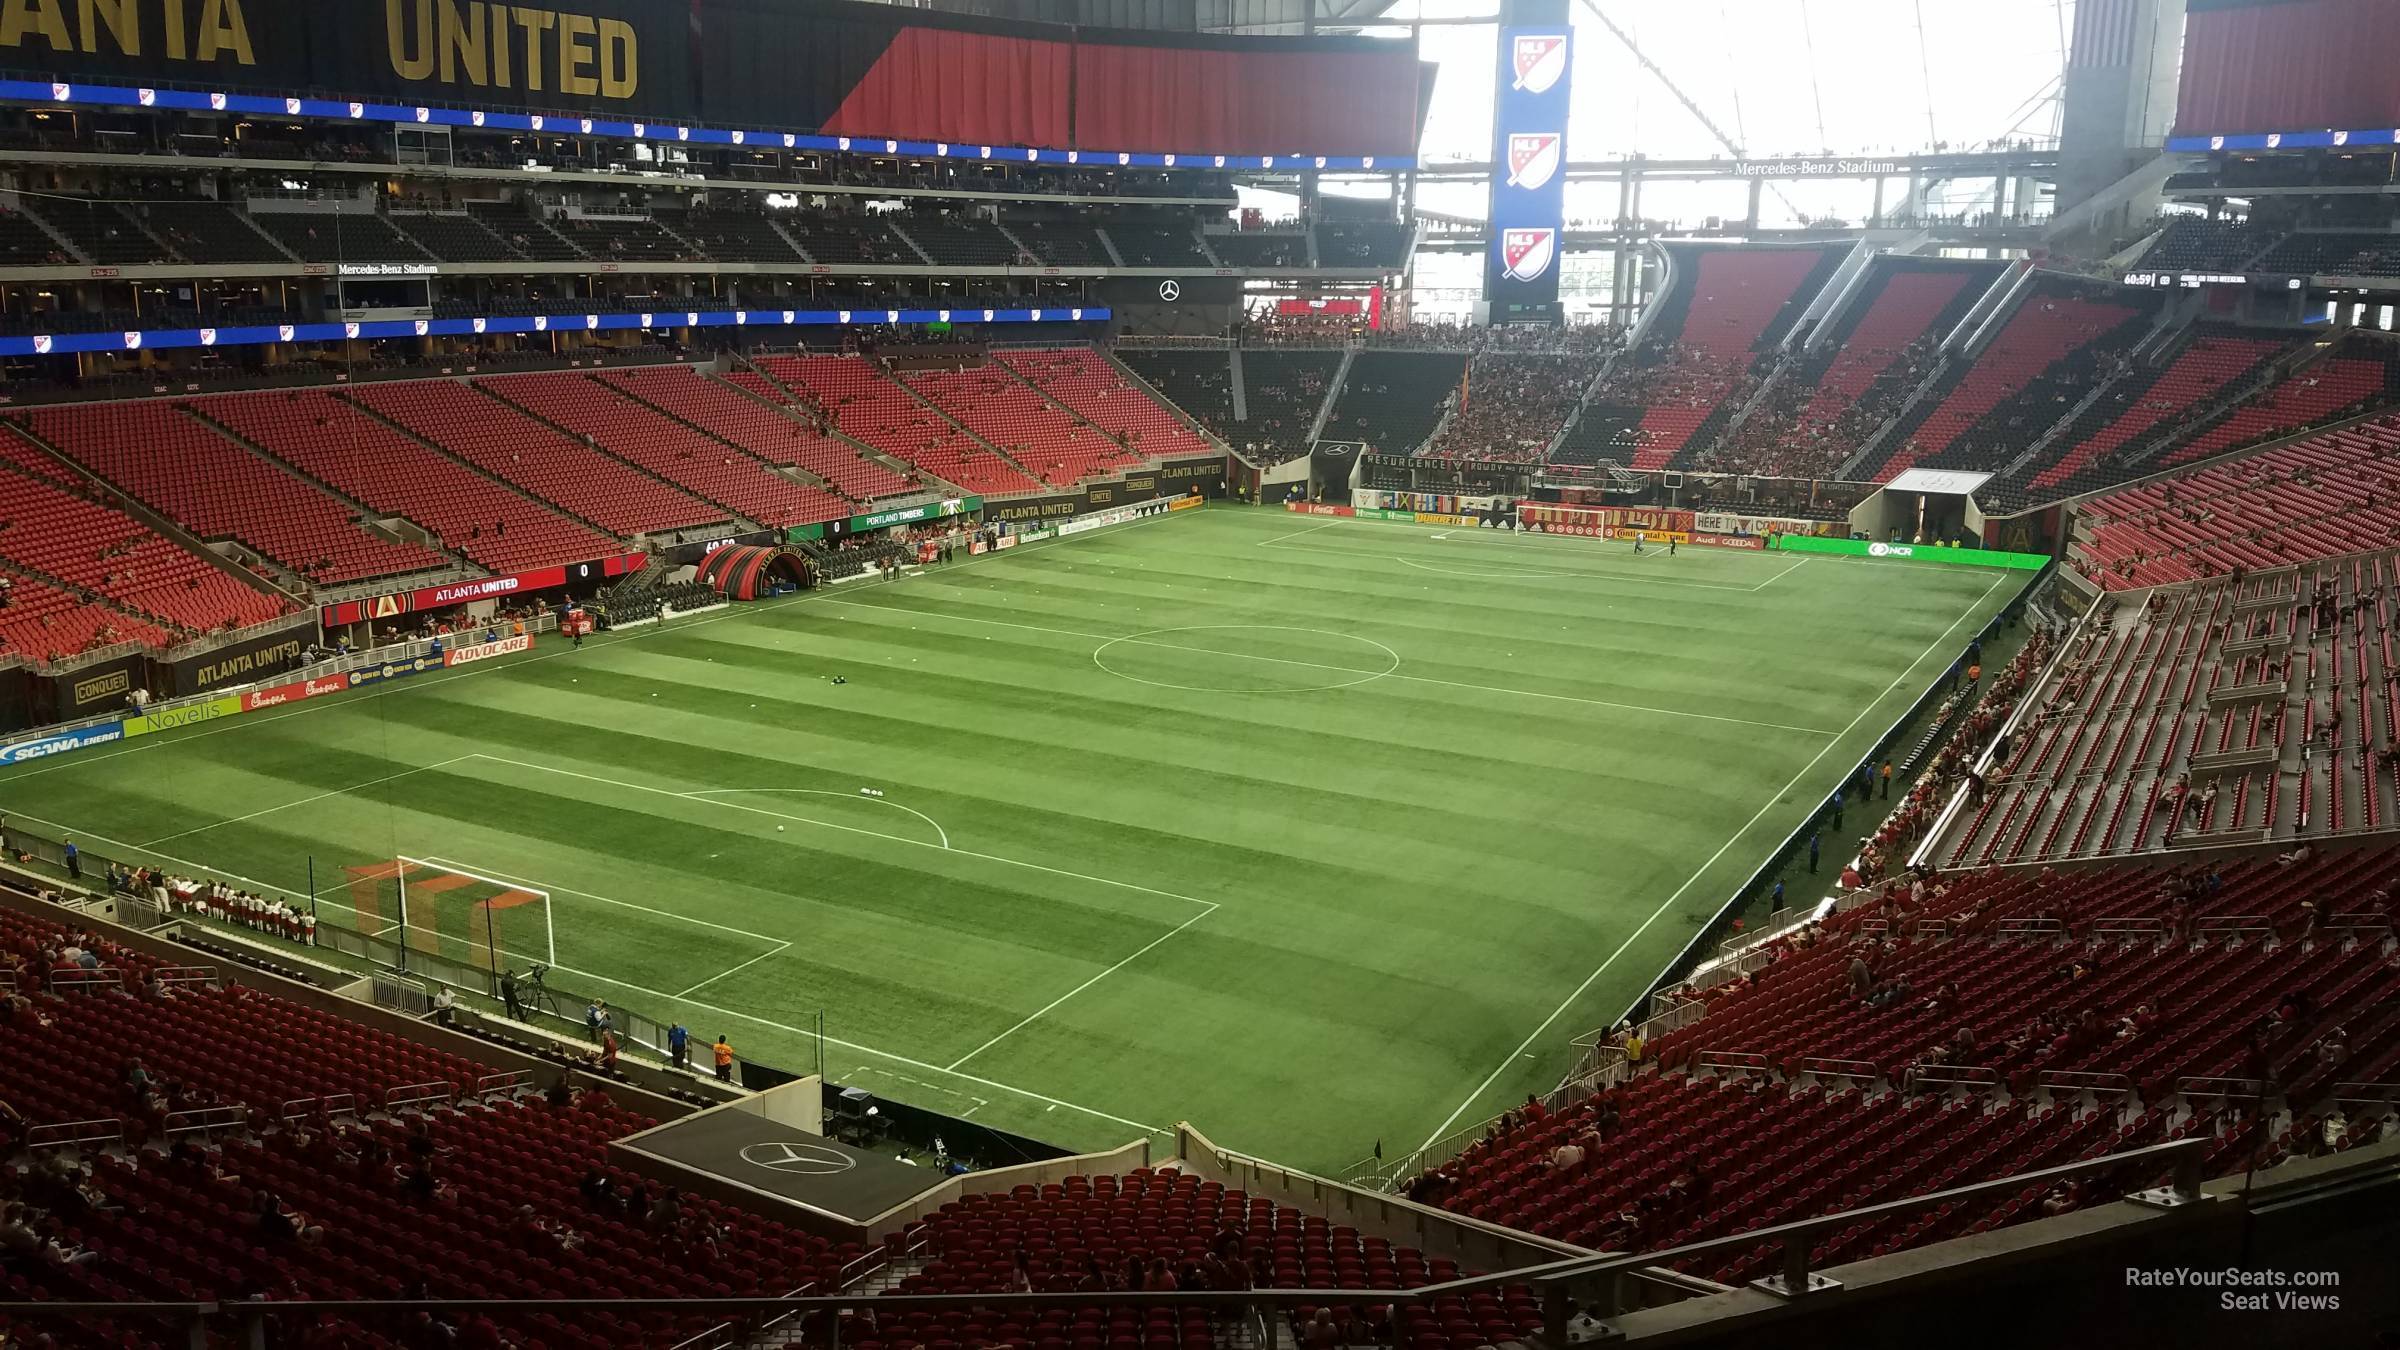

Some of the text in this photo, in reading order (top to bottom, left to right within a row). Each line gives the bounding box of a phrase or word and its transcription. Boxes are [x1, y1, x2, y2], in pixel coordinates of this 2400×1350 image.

[386, 0, 638, 99] UNITED
[1735, 160, 1895, 175] Mercedes-Benz Stadium
[1508, 233, 1534, 246] MLS
[339, 264, 402, 274] Mercedes-Benz
[403, 263, 438, 274] Stadium
[2124, 273, 2152, 285] 60:59
[1194, 464, 1222, 476] UNITED
[1367, 455, 1446, 470] RESURGENCE
[1470, 462, 1502, 472] ROWDY
[1126, 480, 1153, 489] CONQUER
[1092, 492, 1110, 500] UNITE
[866, 508, 925, 526] PORTLAND TIMBERS
[1000, 502, 1074, 520] ATLANTA UNITED
[1415, 513, 1463, 525] QUIKRETE
[1697, 515, 1721, 529] HERE
[1724, 517, 1737, 530] TO
[834, 521, 840, 533] 0
[1020, 529, 1050, 544] Heineken
[1695, 535, 1716, 544] Audi
[1888, 547, 1913, 556] NCR
[580, 564, 588, 577] 0
[435, 585, 480, 602] ATLANTA
[481, 578, 519, 593] UNITED
[450, 636, 529, 666] ADVOCARE
[196, 655, 253, 687] ATLANTA
[78, 676, 126, 699] CONQUER
[146, 703, 220, 732] Novelis
[14, 731, 121, 761] SCANA ENERGY
